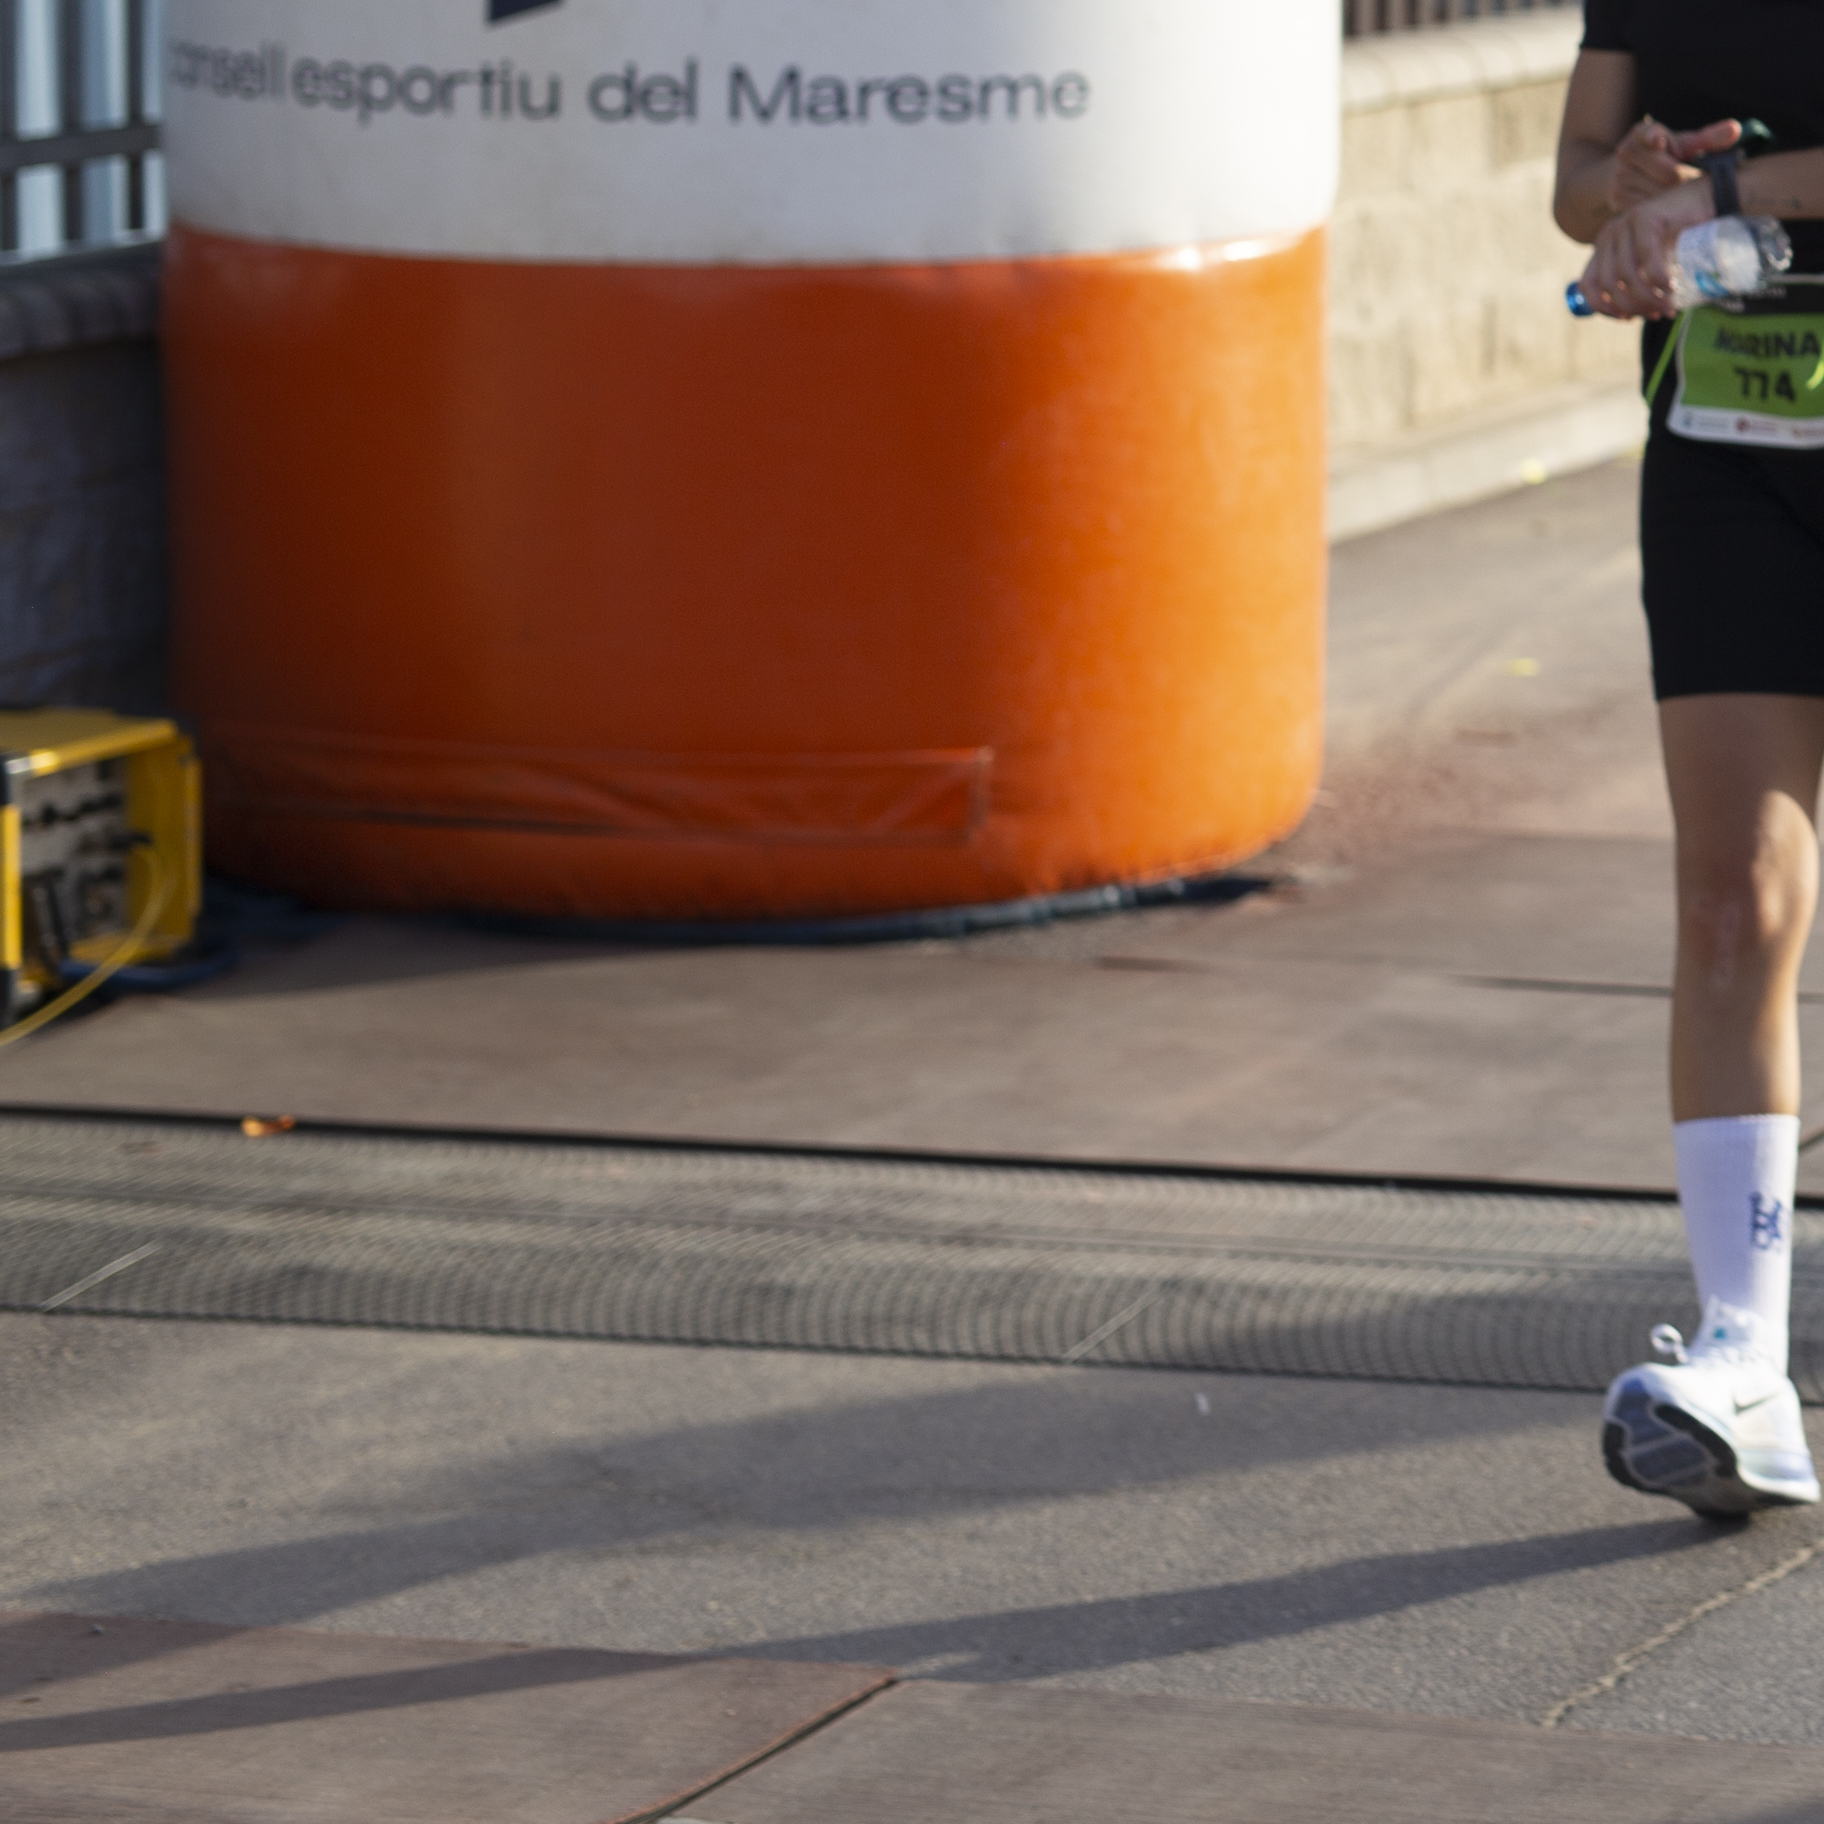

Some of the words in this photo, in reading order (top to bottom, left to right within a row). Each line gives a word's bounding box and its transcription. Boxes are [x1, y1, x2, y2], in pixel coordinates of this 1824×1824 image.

[292, 54, 562, 130] esportiu
[588, 58, 699, 125] del
[727, 62, 1091, 126] Maresme
[1733, 364, 1797, 405] 774
